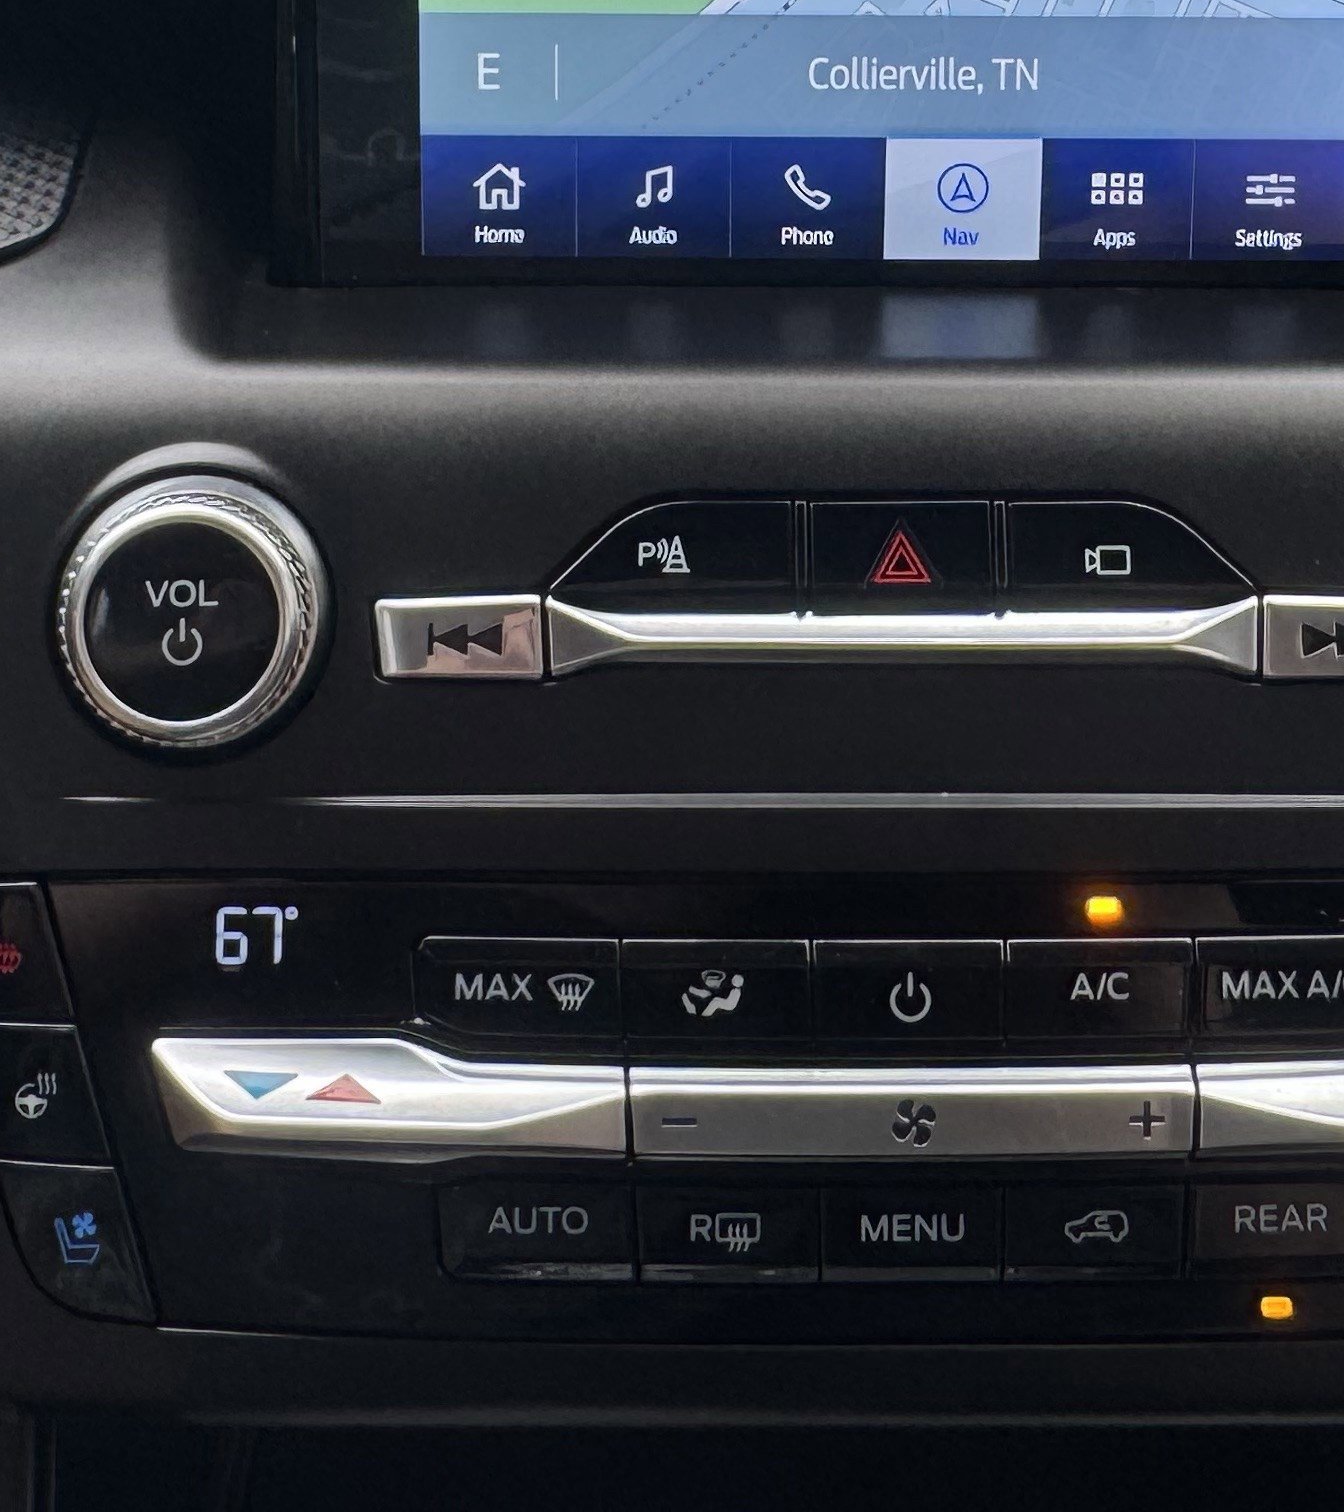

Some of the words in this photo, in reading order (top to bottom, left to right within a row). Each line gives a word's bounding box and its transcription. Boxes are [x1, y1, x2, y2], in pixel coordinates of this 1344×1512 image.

[477, 52, 501, 90] E
[808, 56, 984, 95] Collierville,
[991, 57, 1039, 91] TN
[474, 225, 525, 244] Home
[629, 225, 678, 245] Audio
[781, 226, 834, 246] Phone
[943, 227, 979, 246] Nav
[1093, 228, 1136, 248] Apps
[1234, 228, 1303, 250] Settings
[145, 579, 219, 609] VOL
[215, 905, 299, 966] 67°
[454, 973, 533, 1002] MAX
[1070, 972, 1130, 1002] A/C
[1221, 971, 1299, 1001] MAX
[488, 1206, 589, 1235] AUTO
[690, 1214, 711, 1243] R
[861, 1213, 966, 1243] MENU
[1234, 1204, 1329, 1233] REAR
